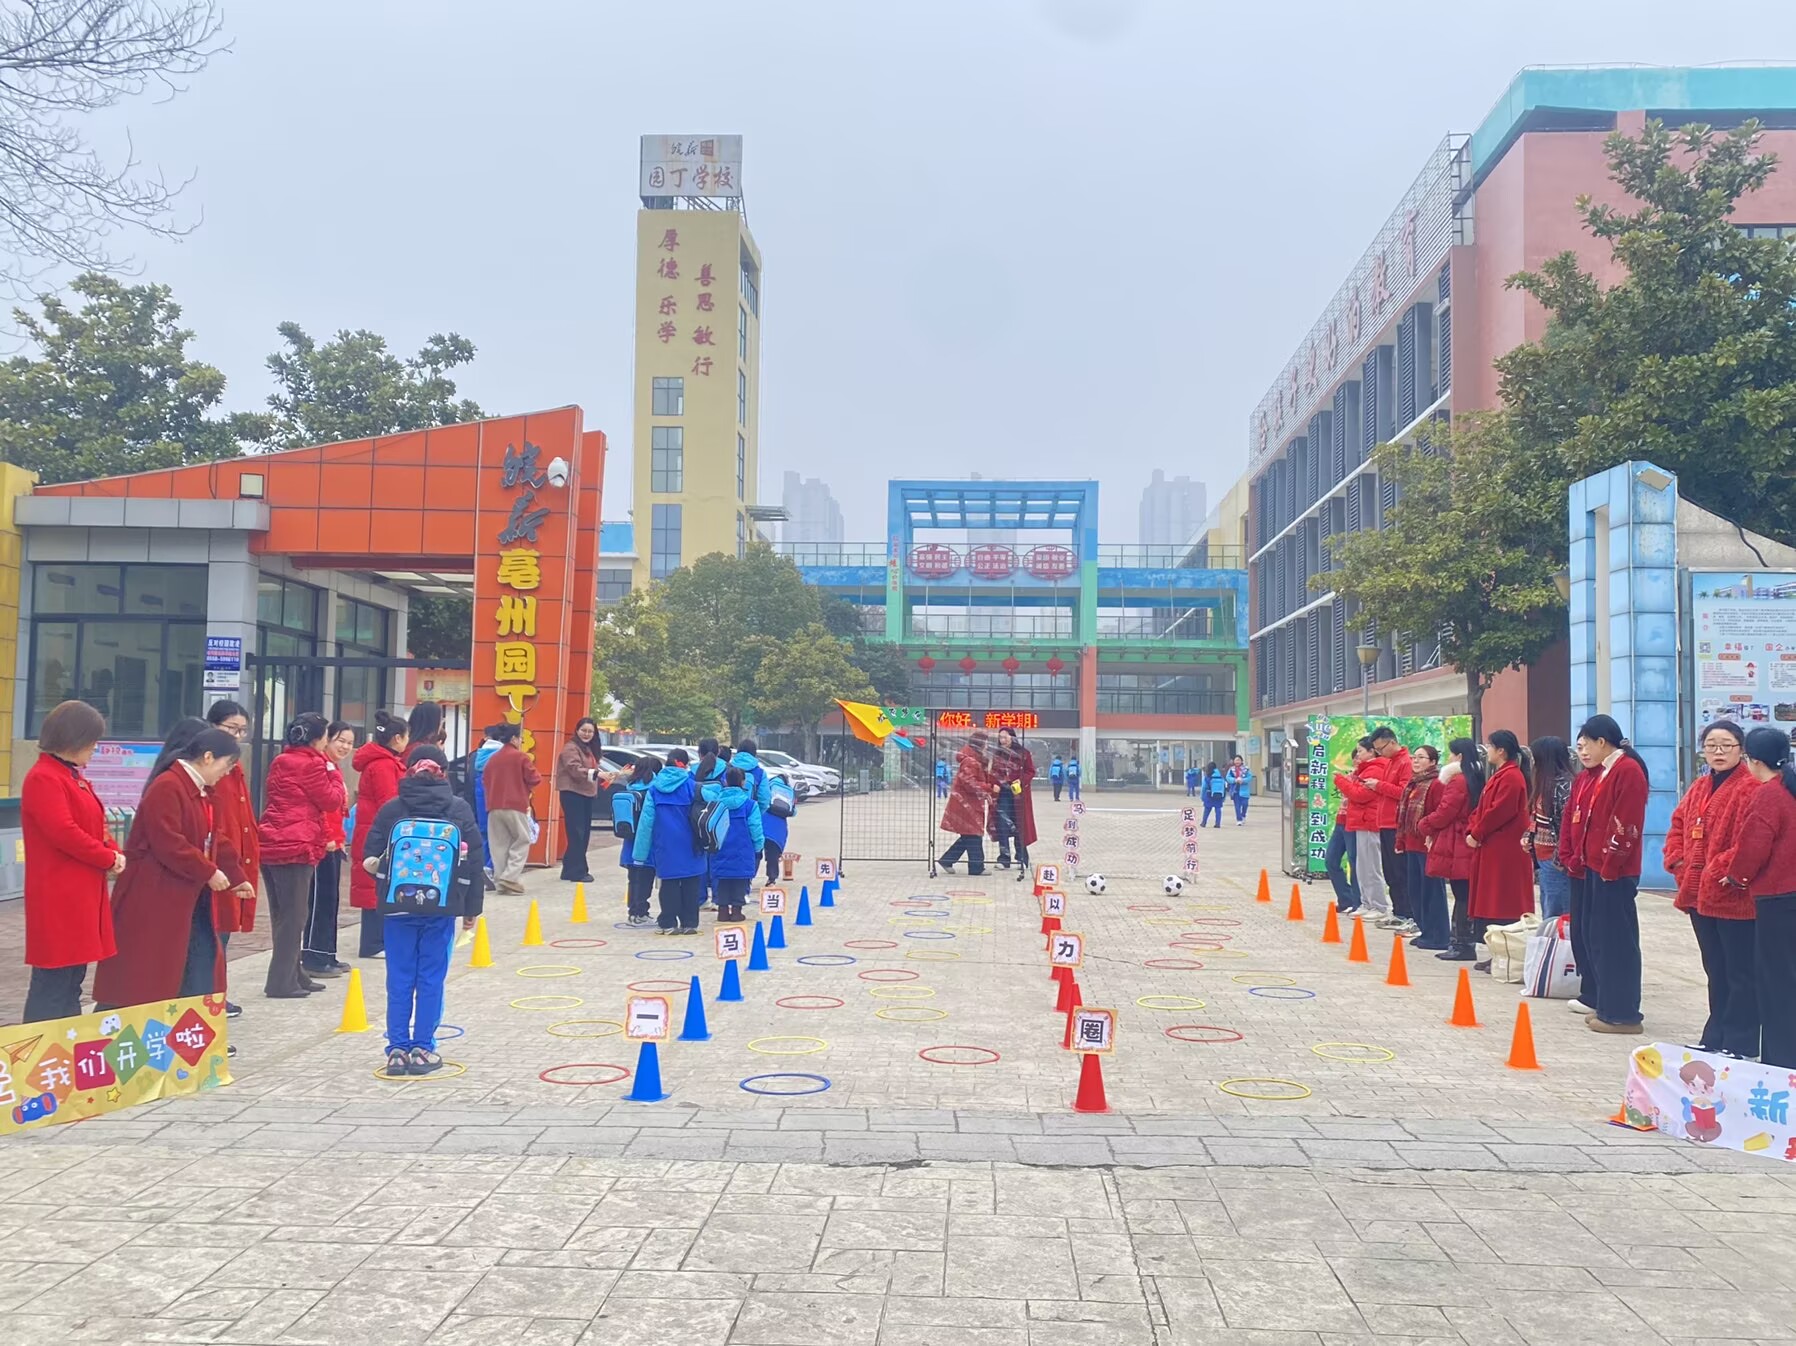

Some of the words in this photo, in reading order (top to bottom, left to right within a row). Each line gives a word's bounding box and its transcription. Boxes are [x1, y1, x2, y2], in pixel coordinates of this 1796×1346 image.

[649, 164, 734, 190] 园丁学校
[658, 229, 680, 344] 厚德乐学
[692, 263, 716, 377] 善思敏行
[1310, 744, 1328, 791] 启新程
[1065, 803, 1084, 864] 马到成功
[1310, 812, 1328, 859] 到成功
[820, 863, 831, 875] 先
[1043, 869, 1055, 882] 赴
[767, 894, 780, 909] 当
[1050, 898, 1060, 910] 以
[723, 934, 739, 951] 马
[1058, 941, 1074, 958] 力
[1080, 1019, 1105, 1044] 圈
[39, 1023, 206, 1090] 我们开学啦
[1747, 1080, 1790, 1125] 新
